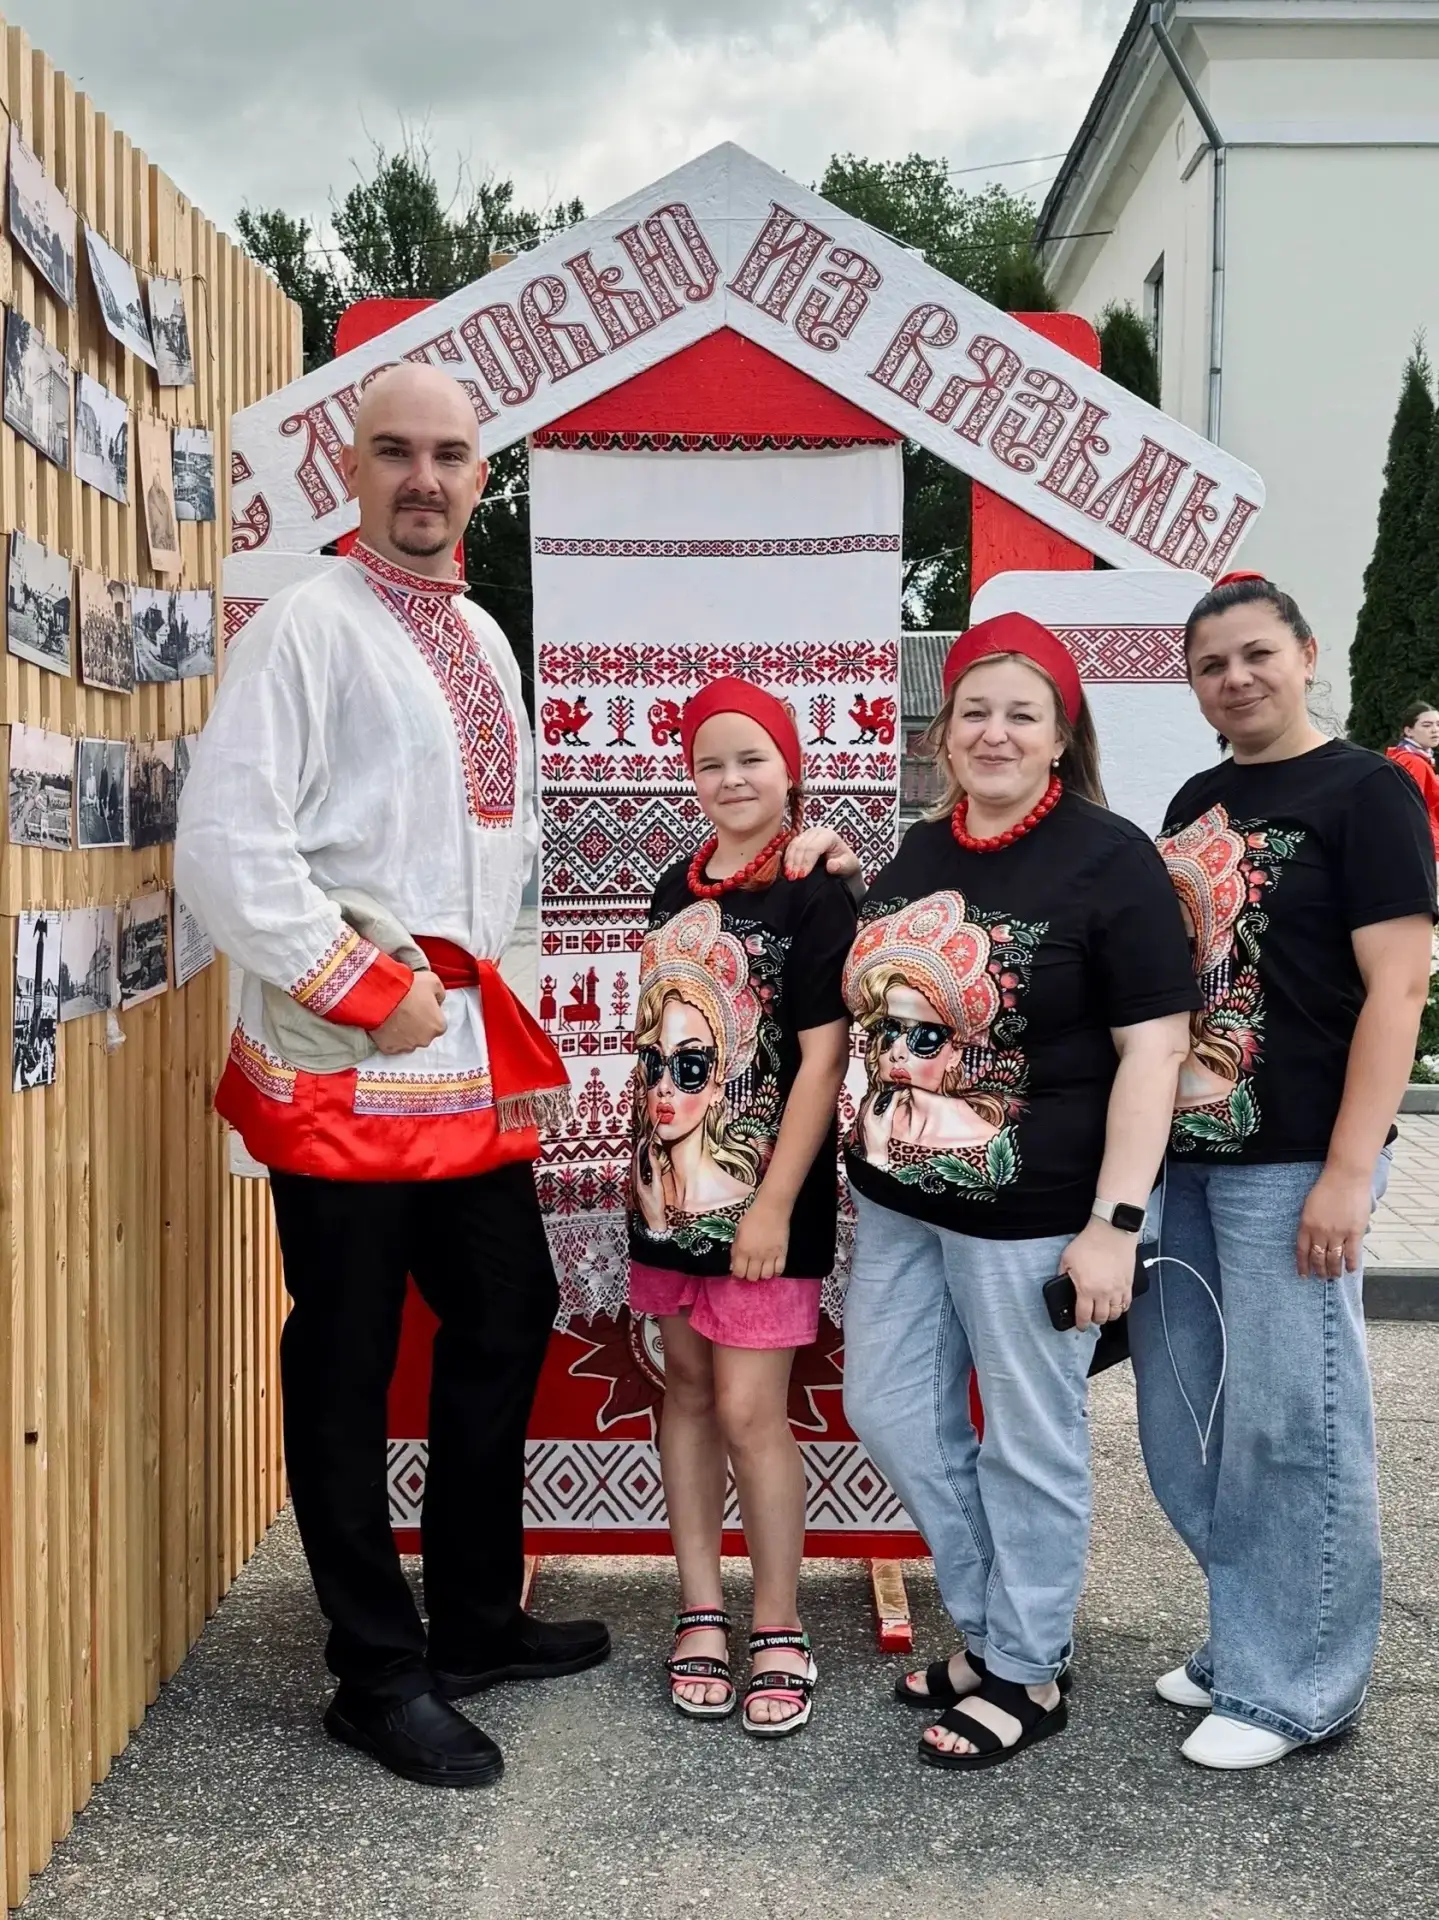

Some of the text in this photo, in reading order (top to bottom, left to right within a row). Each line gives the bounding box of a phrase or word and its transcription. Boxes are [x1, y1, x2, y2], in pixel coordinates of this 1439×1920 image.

[724, 200, 884, 352] ИЗ
[866, 302, 1260, 582] ВЯЗЬМЫ
[696, 1614, 723, 1622] FOREVER
[766, 1636, 788, 1645] YOUNG
